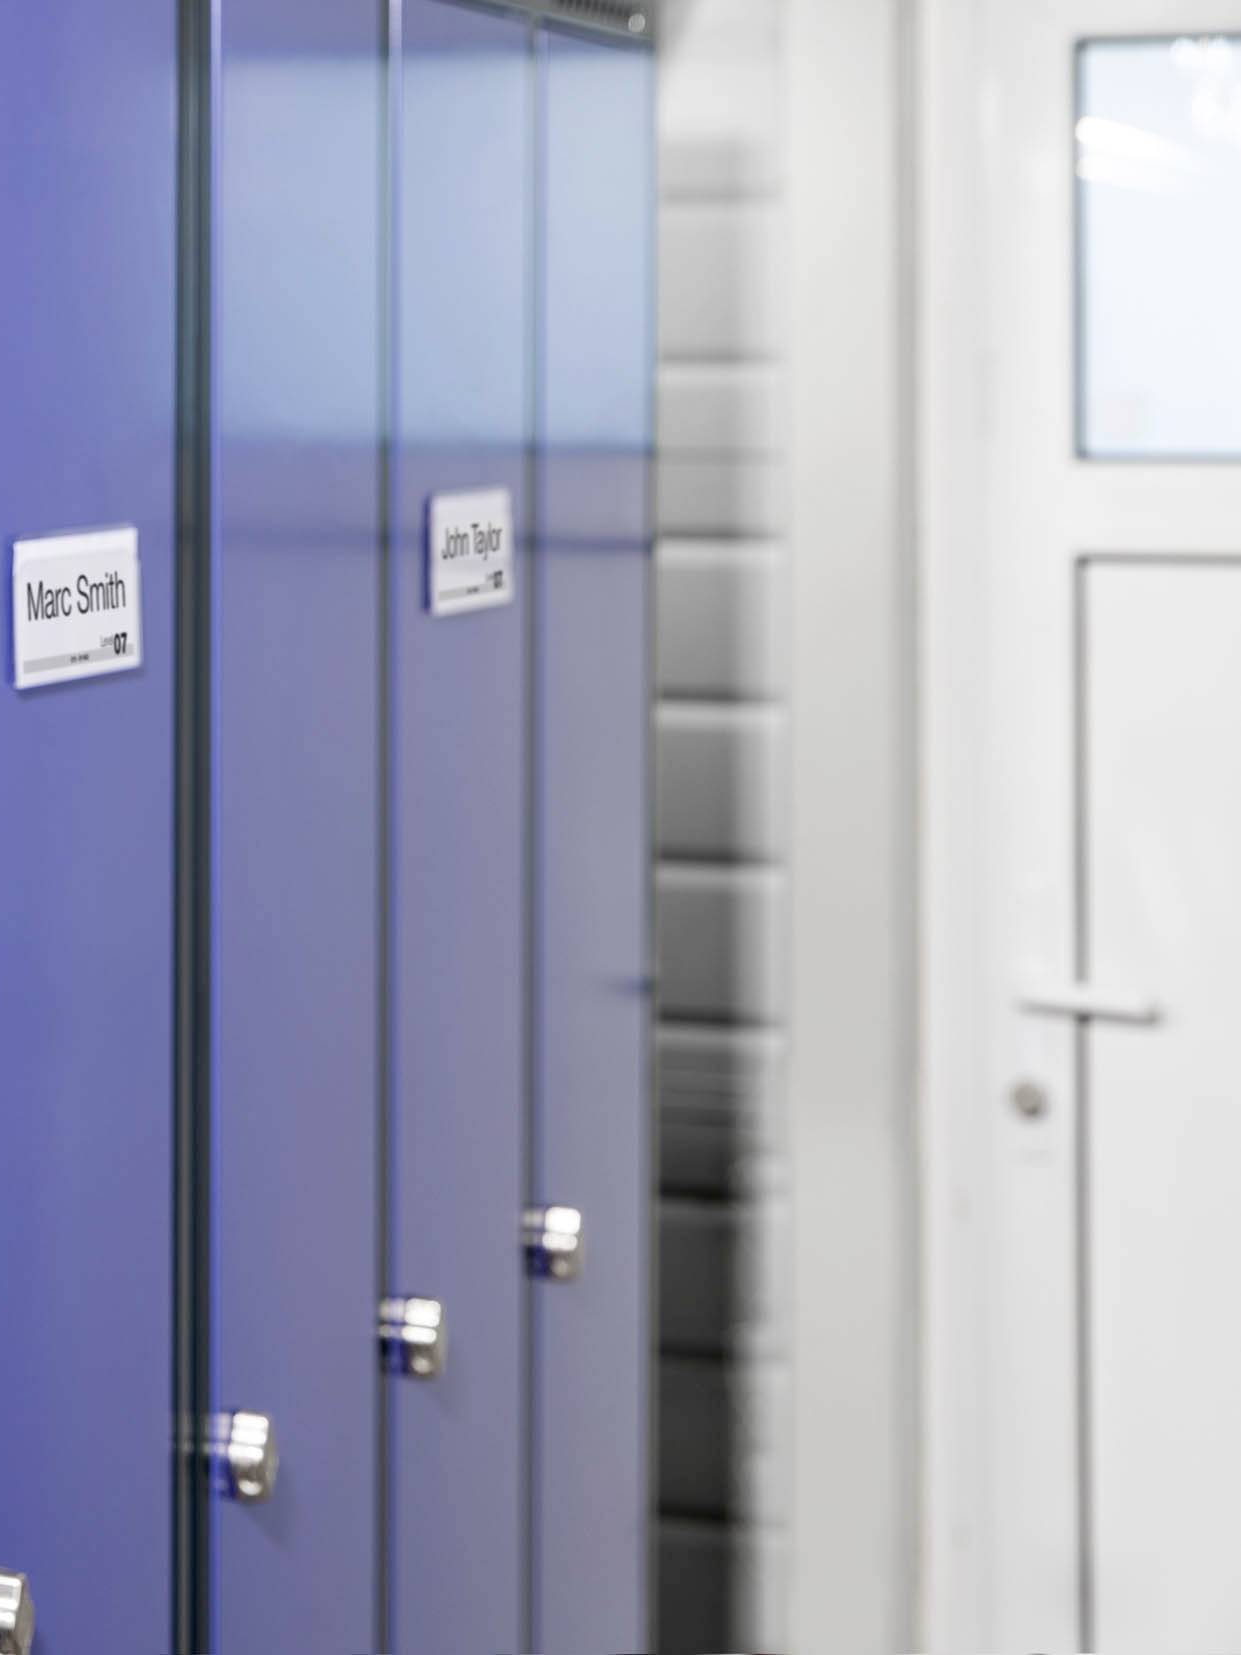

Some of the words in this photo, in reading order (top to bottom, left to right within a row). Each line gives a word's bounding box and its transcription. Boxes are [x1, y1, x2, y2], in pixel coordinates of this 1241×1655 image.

[441, 524, 470, 560] John
[471, 520, 502, 560] Taylor
[26, 580, 72, 622] Marc
[76, 570, 126, 614] Smith
[113, 631, 128, 655] 07
